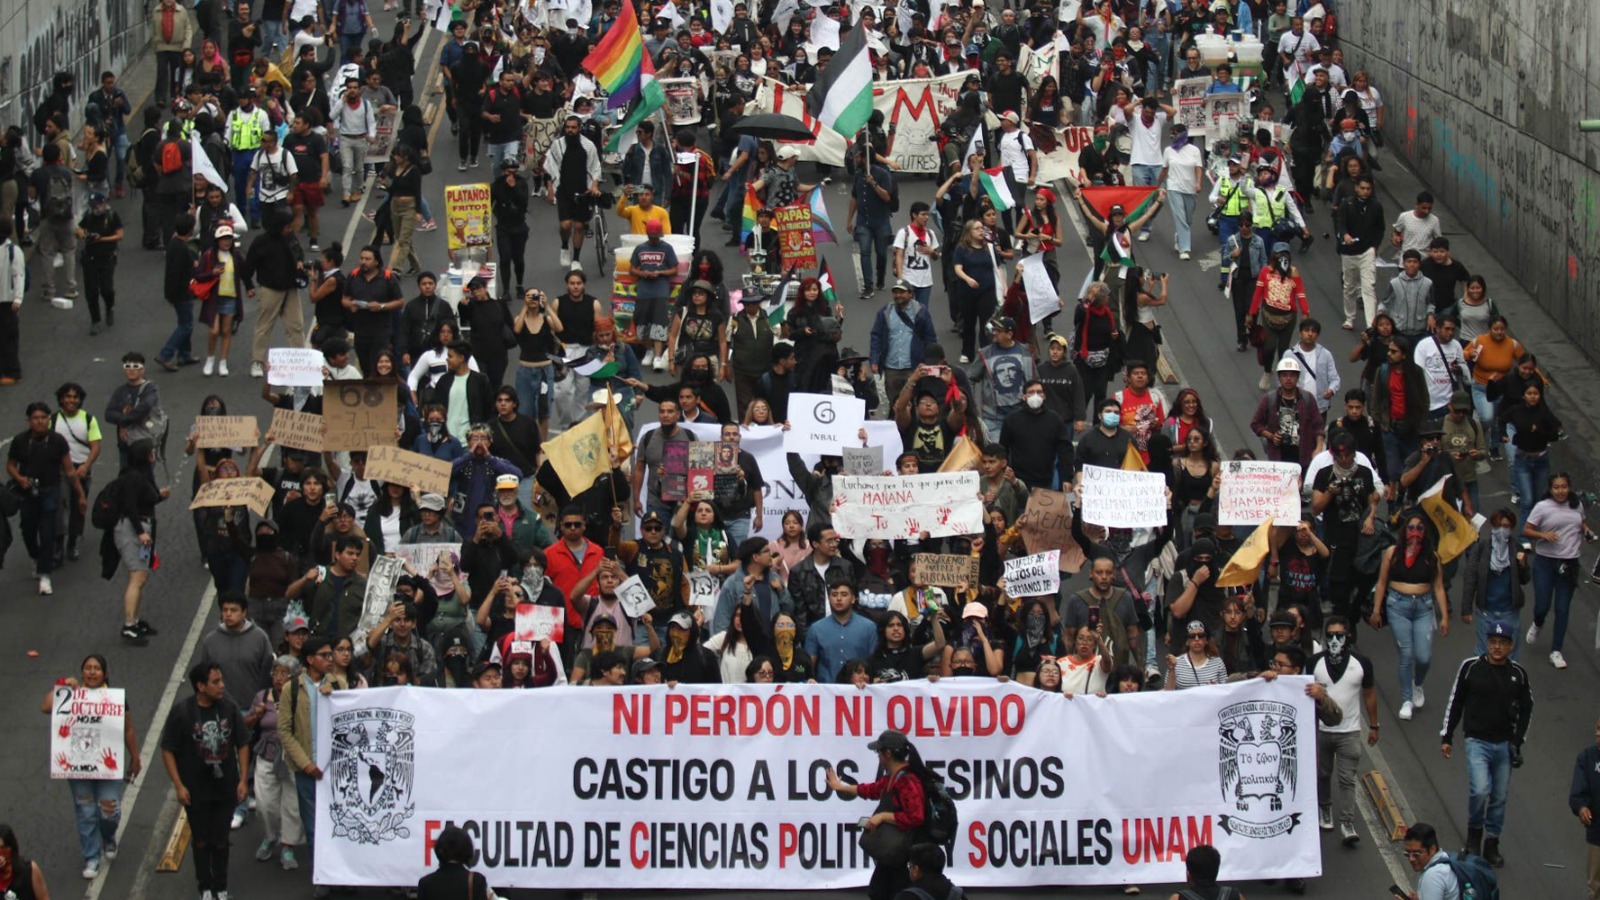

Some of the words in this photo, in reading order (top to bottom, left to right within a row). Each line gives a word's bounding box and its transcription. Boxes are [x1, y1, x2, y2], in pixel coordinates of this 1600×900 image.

[776, 208, 811, 224] PAPAS
[1084, 467, 1102, 480] NO
[1230, 497, 1281, 507] HAMBRE
[56, 687, 72, 716] 2
[73, 689, 88, 701] DE
[72, 702, 124, 716] OCTUBRE
[613, 694, 652, 735] NI
[665, 686, 820, 736] PERDÓN
[835, 695, 873, 737] NI
[886, 693, 1026, 738] OLVIDO
[573, 756, 735, 801] CASTIGO
[747, 758, 775, 801] A
[787, 758, 860, 802] LOS
[876, 756, 1064, 801] SINOS
[425, 819, 574, 868] FCULTAD
[584, 821, 621, 868] DE
[630, 821, 769, 870] CIENCIAS
[968, 818, 1112, 868] SOCIALES
[1122, 815, 1213, 865] UNAM
